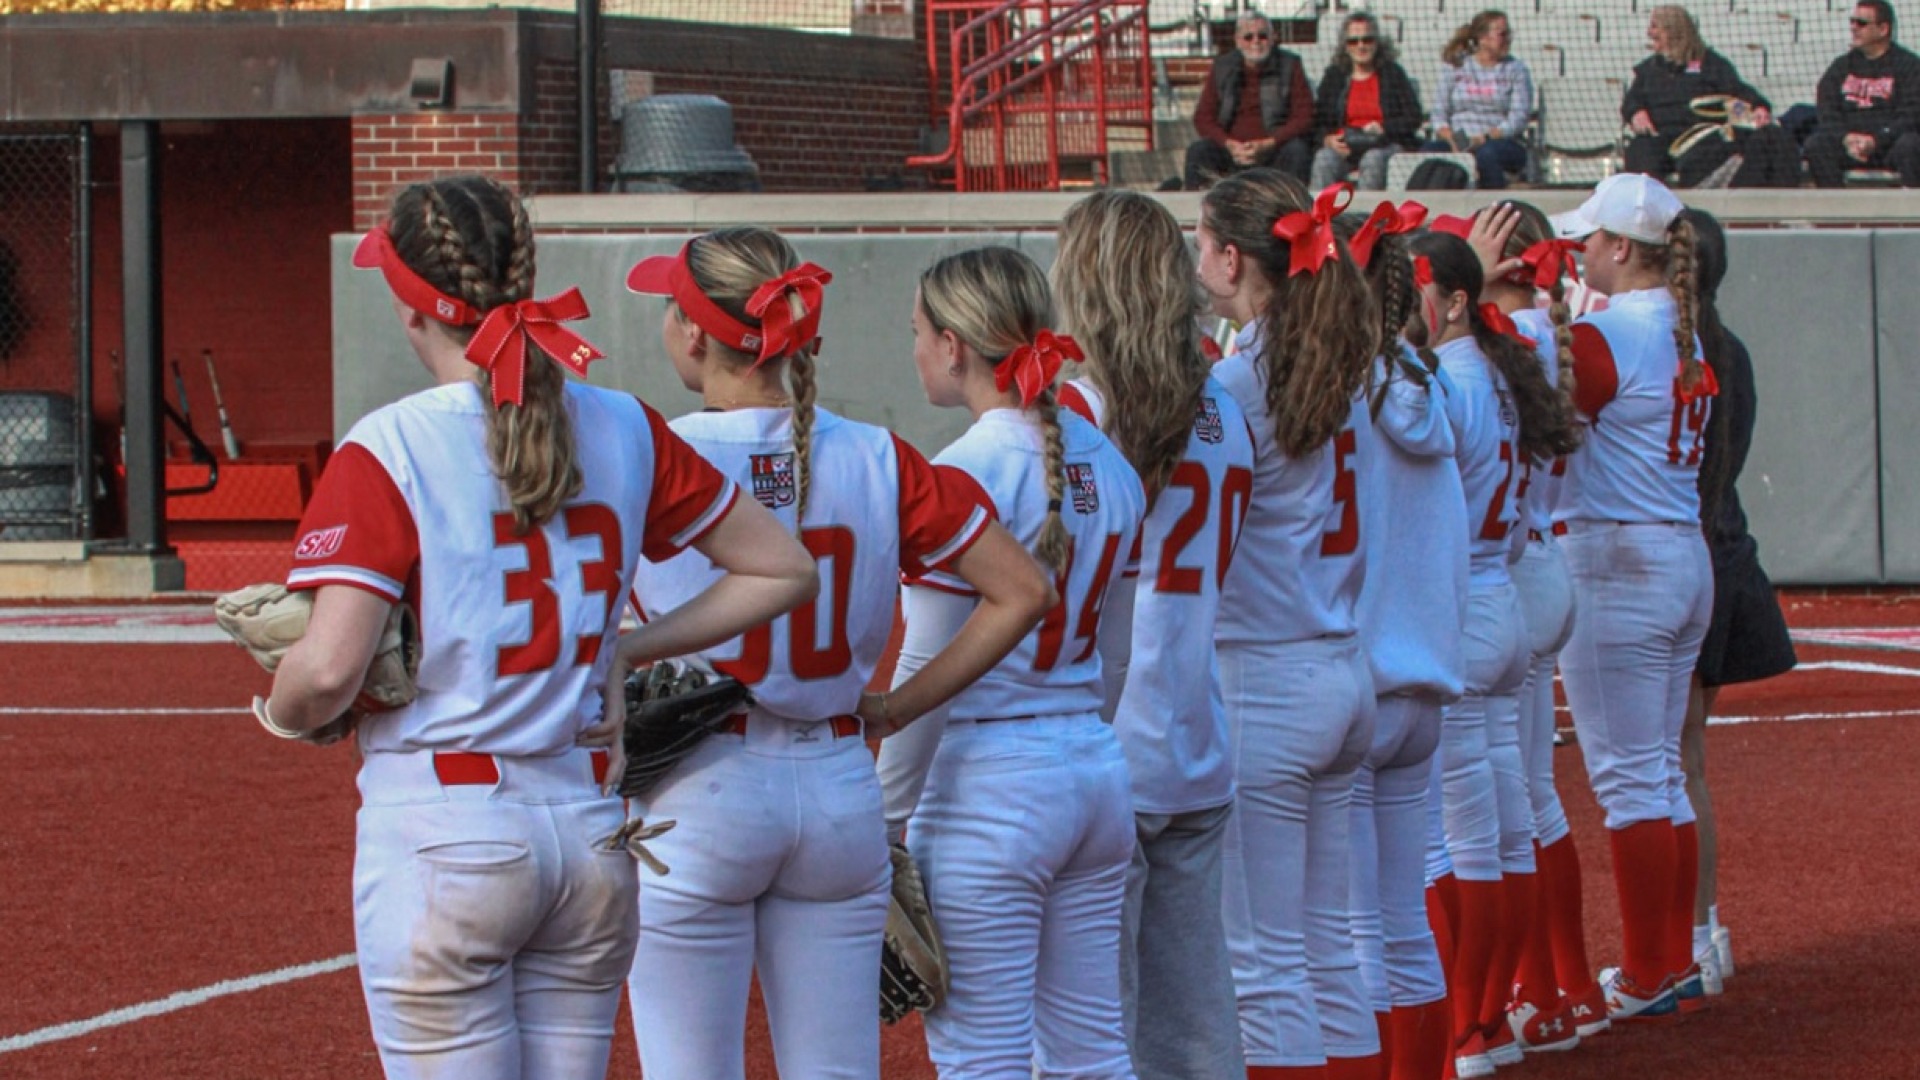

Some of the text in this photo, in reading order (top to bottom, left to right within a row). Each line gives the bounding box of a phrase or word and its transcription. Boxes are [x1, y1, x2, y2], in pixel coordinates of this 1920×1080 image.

[570, 344, 591, 366] 33
[296, 525, 348, 559] SHU
[1153, 460, 1254, 595] 20
[492, 502, 624, 679] 33
